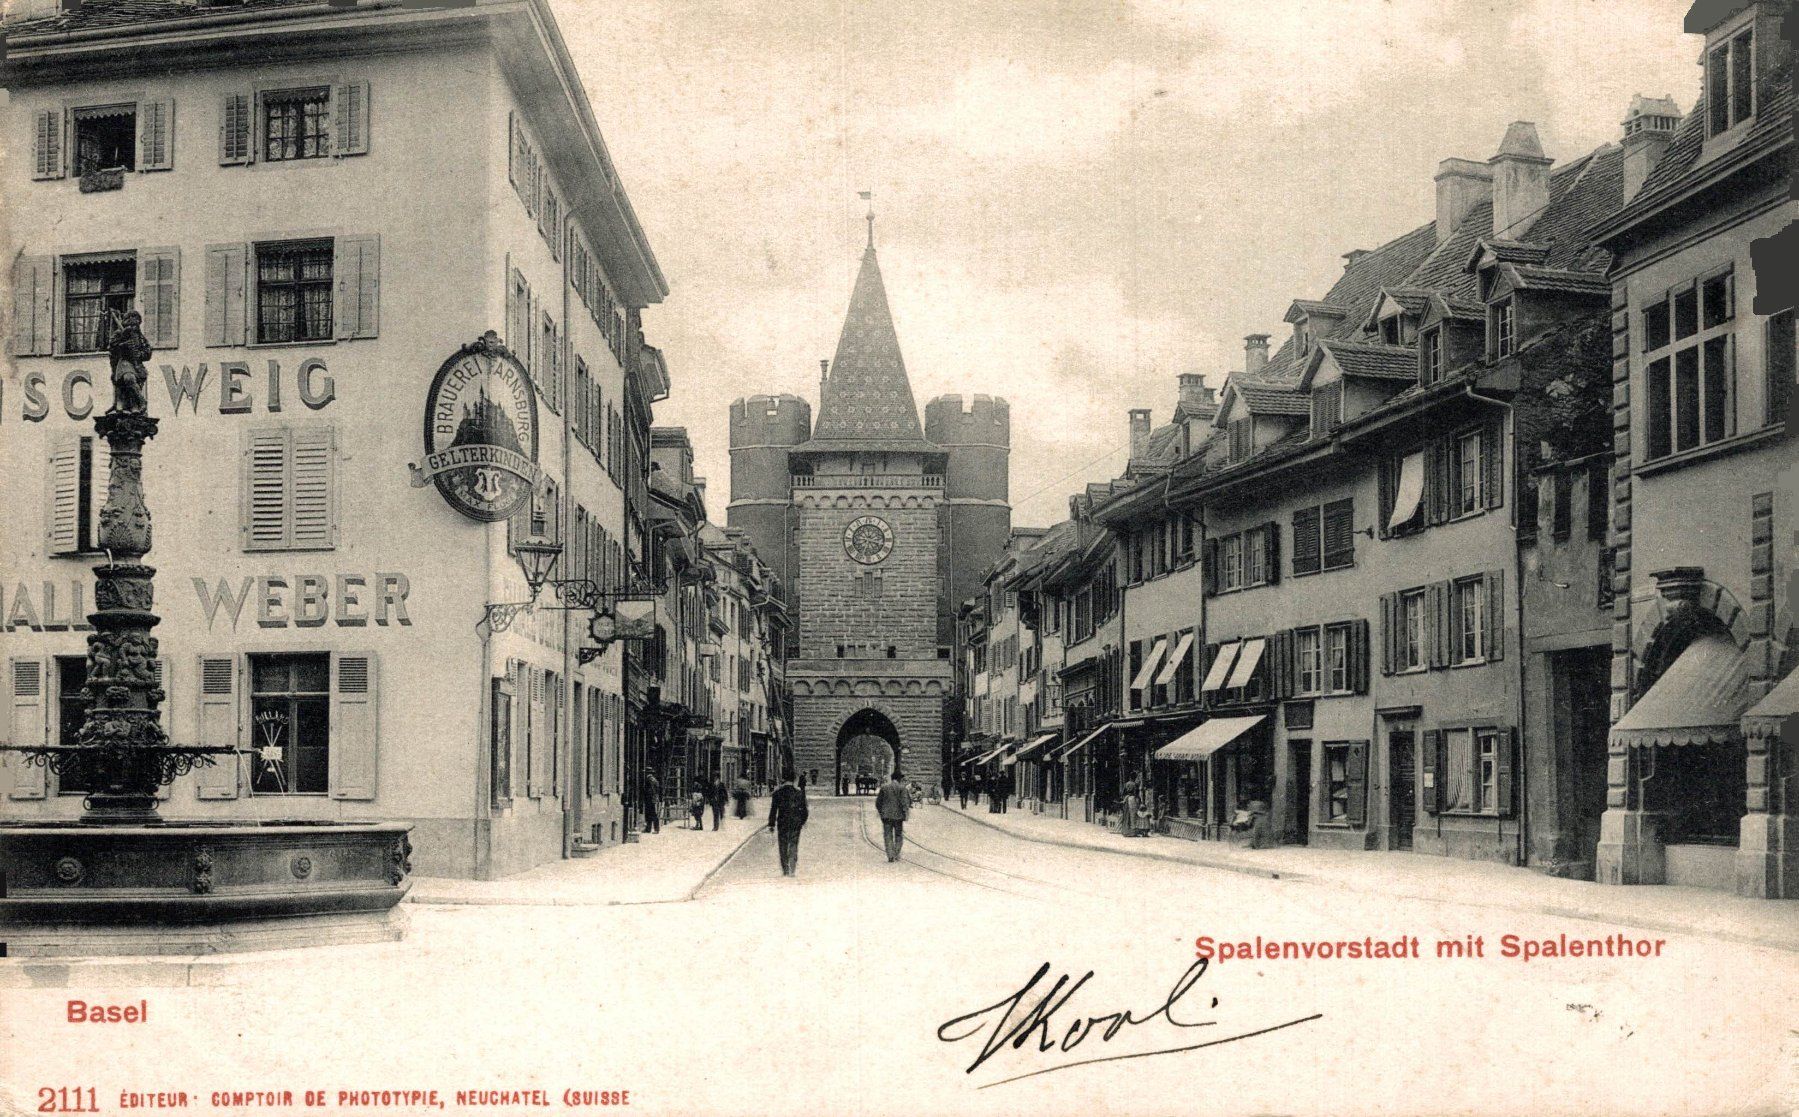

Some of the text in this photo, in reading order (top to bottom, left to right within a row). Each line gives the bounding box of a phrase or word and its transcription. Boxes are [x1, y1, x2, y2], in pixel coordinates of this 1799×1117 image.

[0, 357, 336, 423] SCWEIG
[436, 357, 484, 434] BRAUEREI
[429, 446, 538, 480] GELTERKINDEN
[0, 571, 413, 634] ALL WEBER
